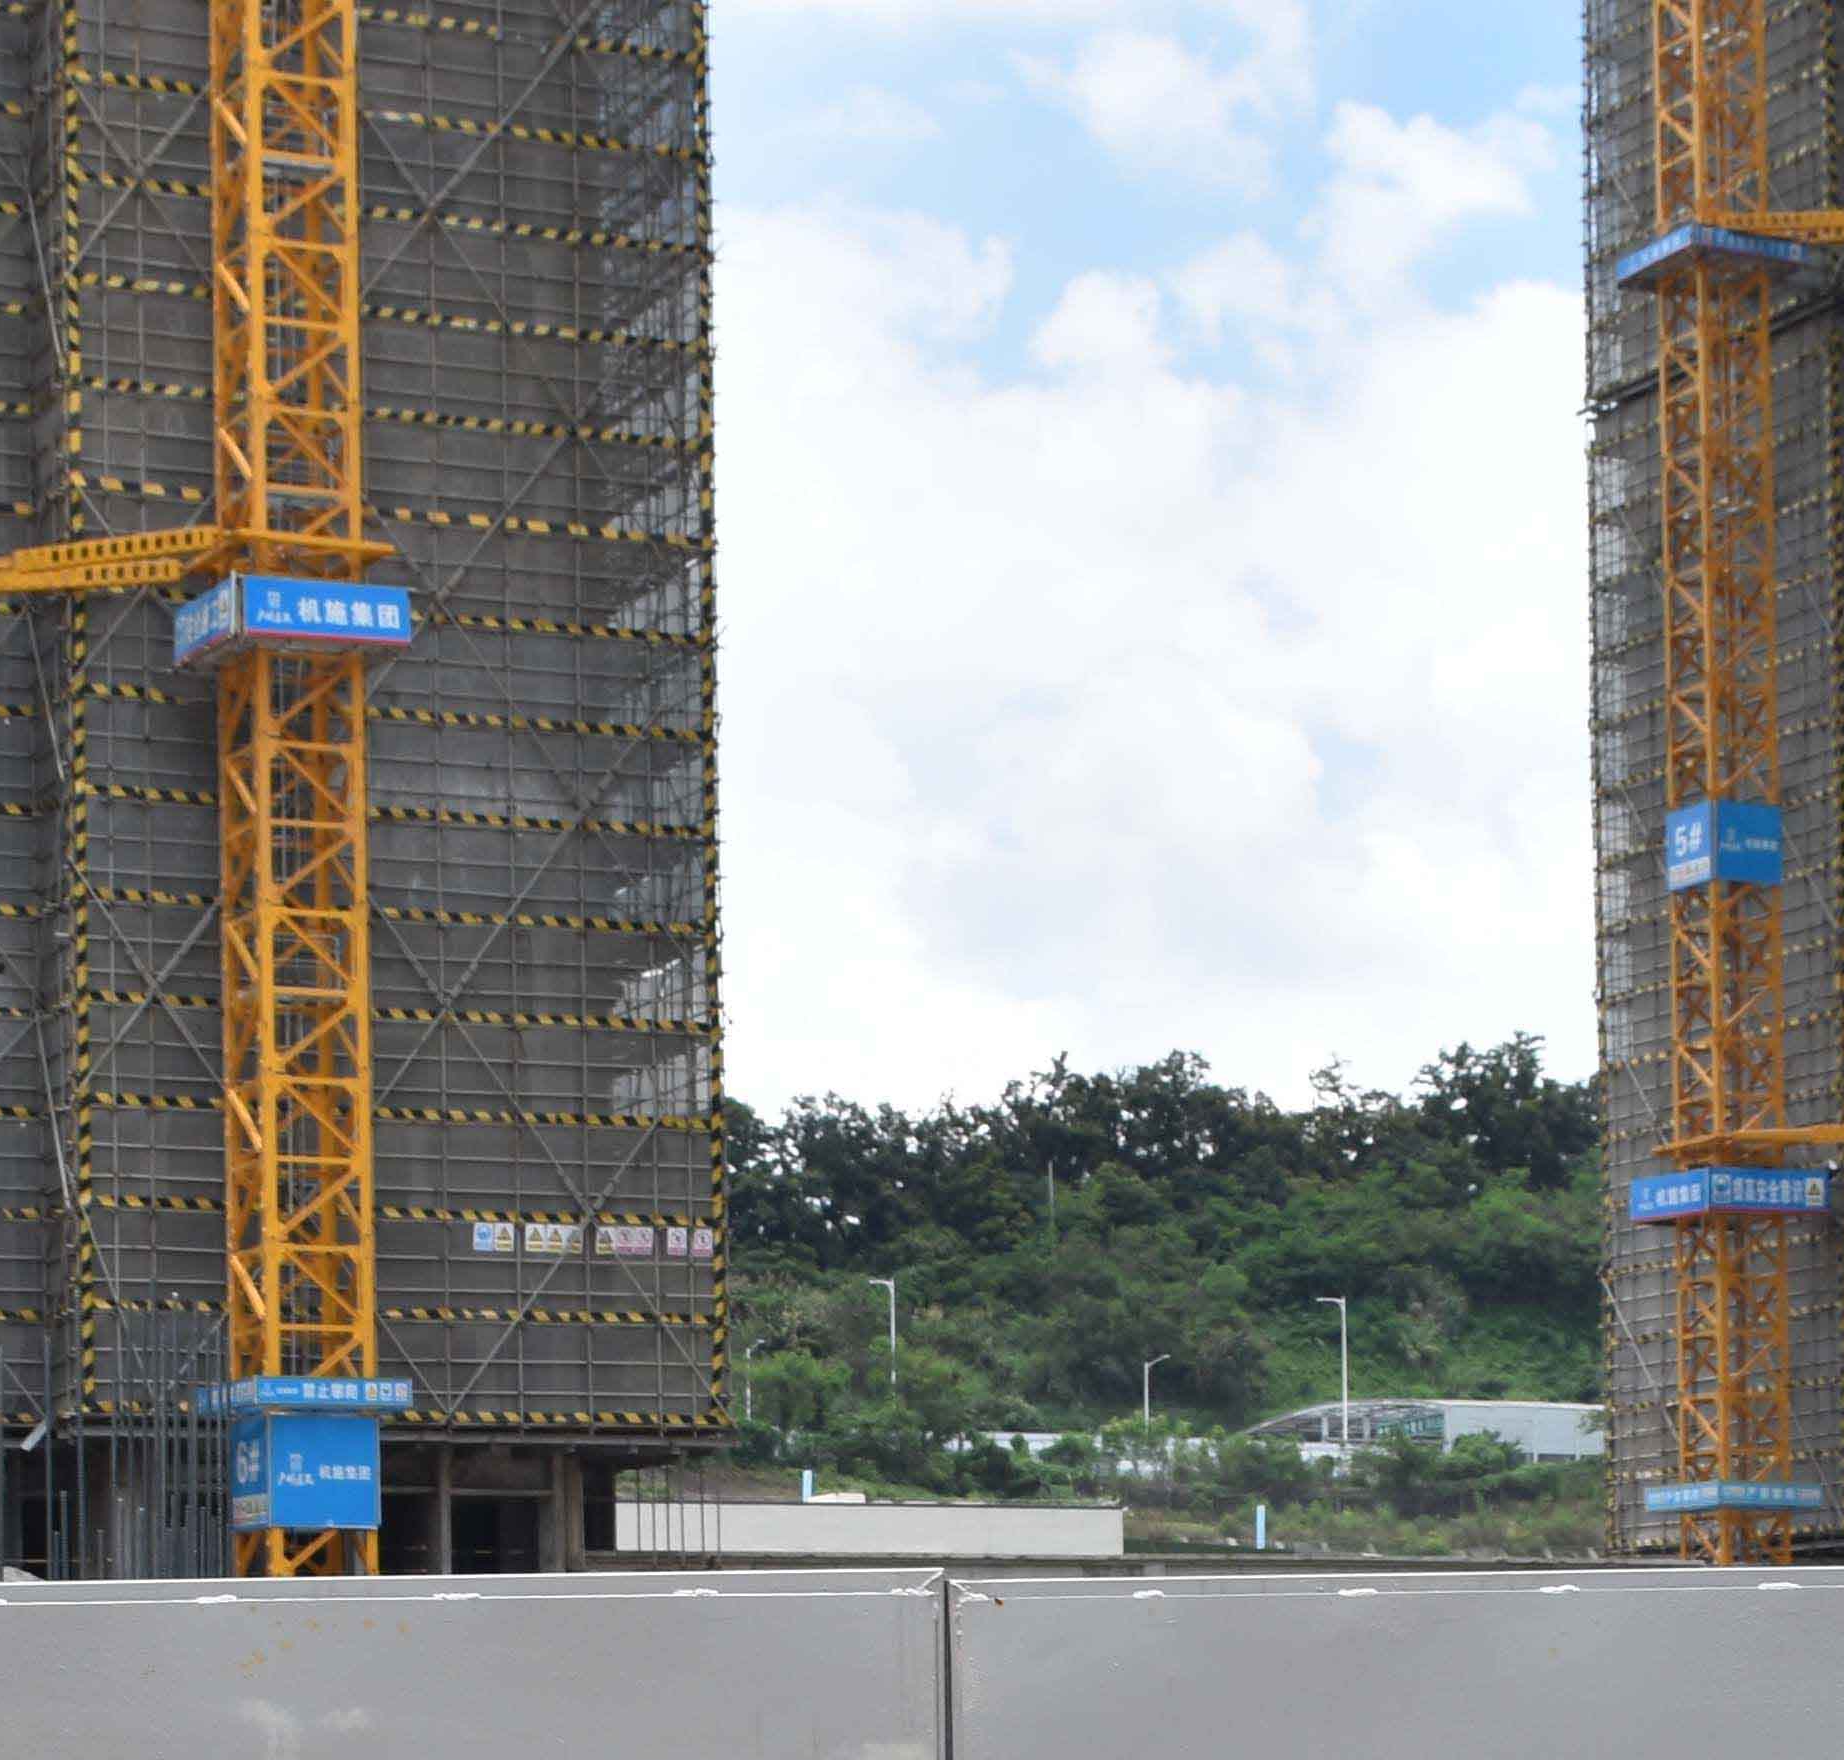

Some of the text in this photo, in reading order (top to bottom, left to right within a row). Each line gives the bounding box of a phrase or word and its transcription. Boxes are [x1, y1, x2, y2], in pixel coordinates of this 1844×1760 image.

[297, 597, 401, 629] 机施集团
[1675, 821, 1702, 858] 5#
